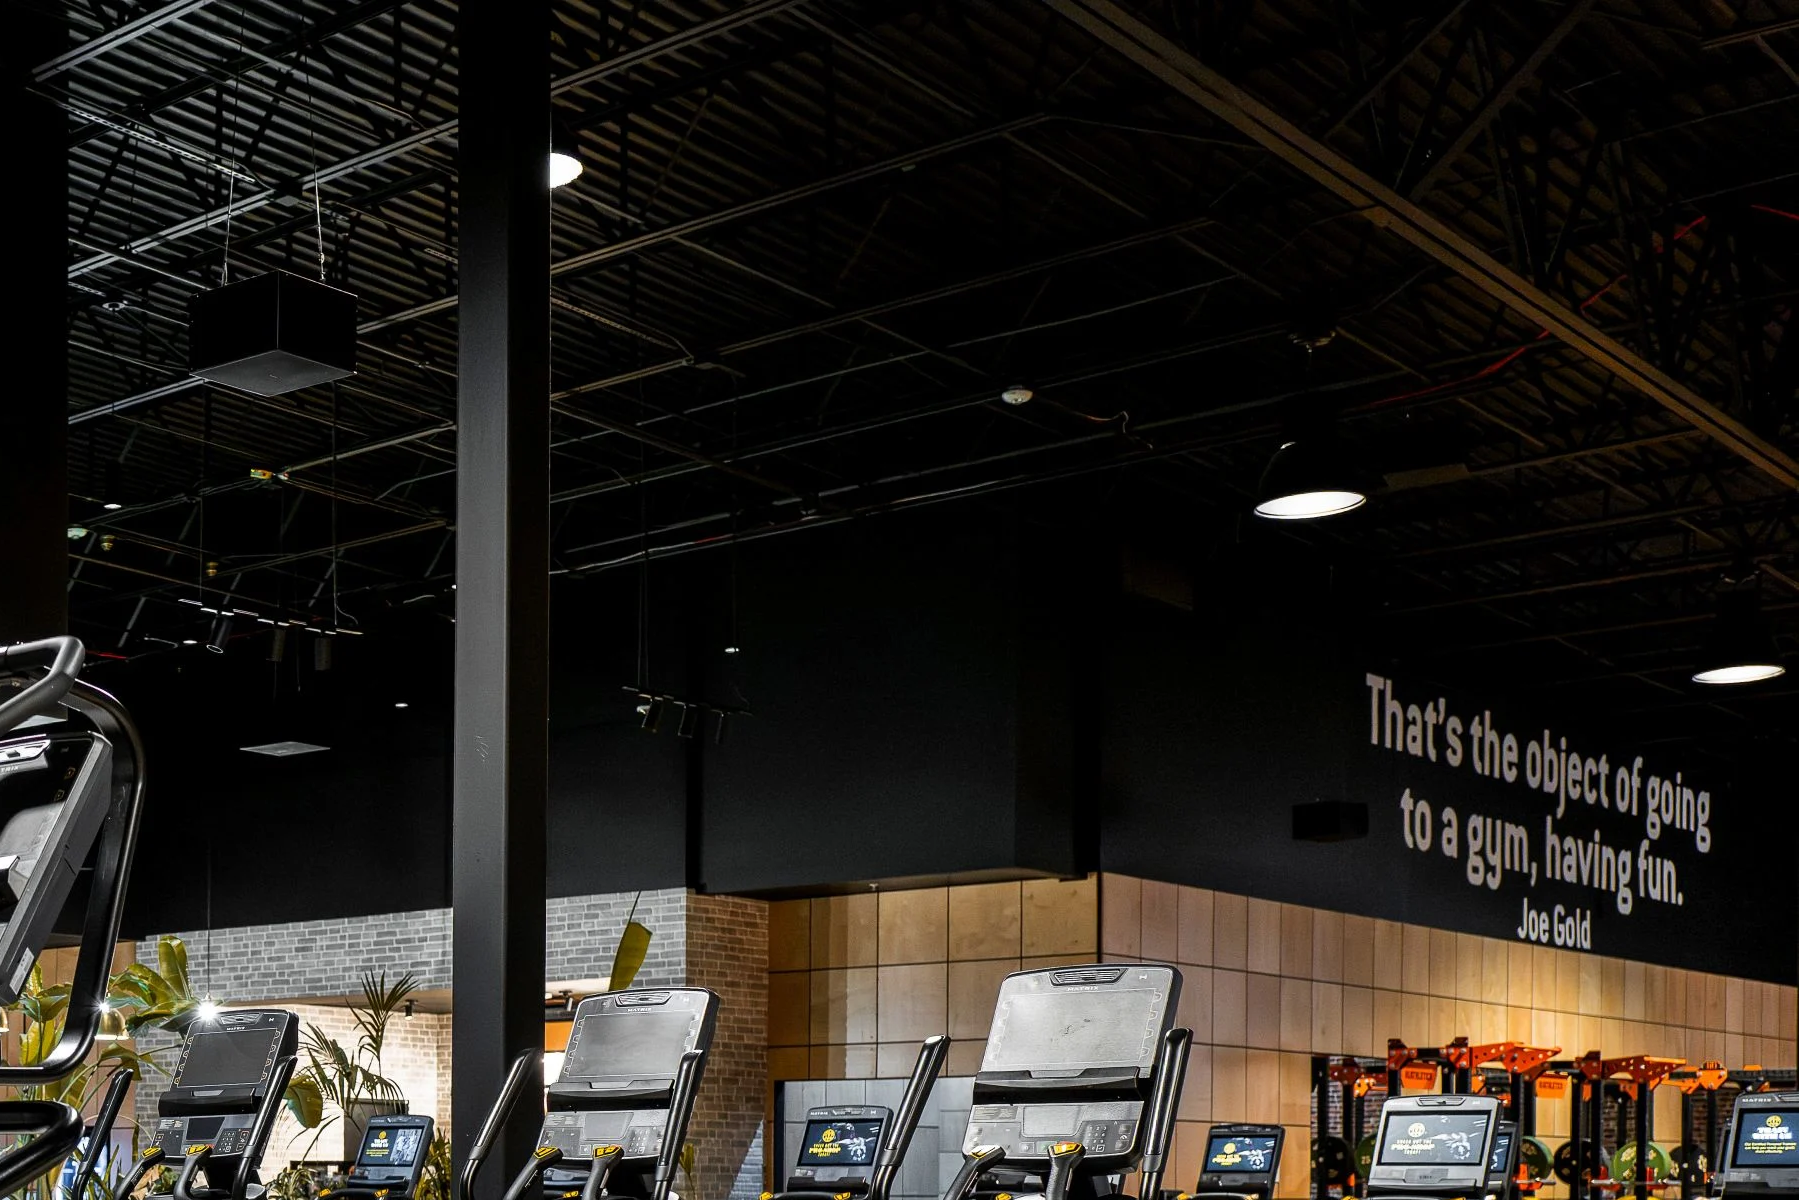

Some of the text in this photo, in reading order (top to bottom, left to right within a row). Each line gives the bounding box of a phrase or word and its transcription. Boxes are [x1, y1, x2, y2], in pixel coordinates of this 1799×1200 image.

[1366, 673, 1711, 853] That's the object of going
[1401, 788, 1684, 915] to a gym, having fun.
[1517, 898, 1591, 950] Joe Gold
